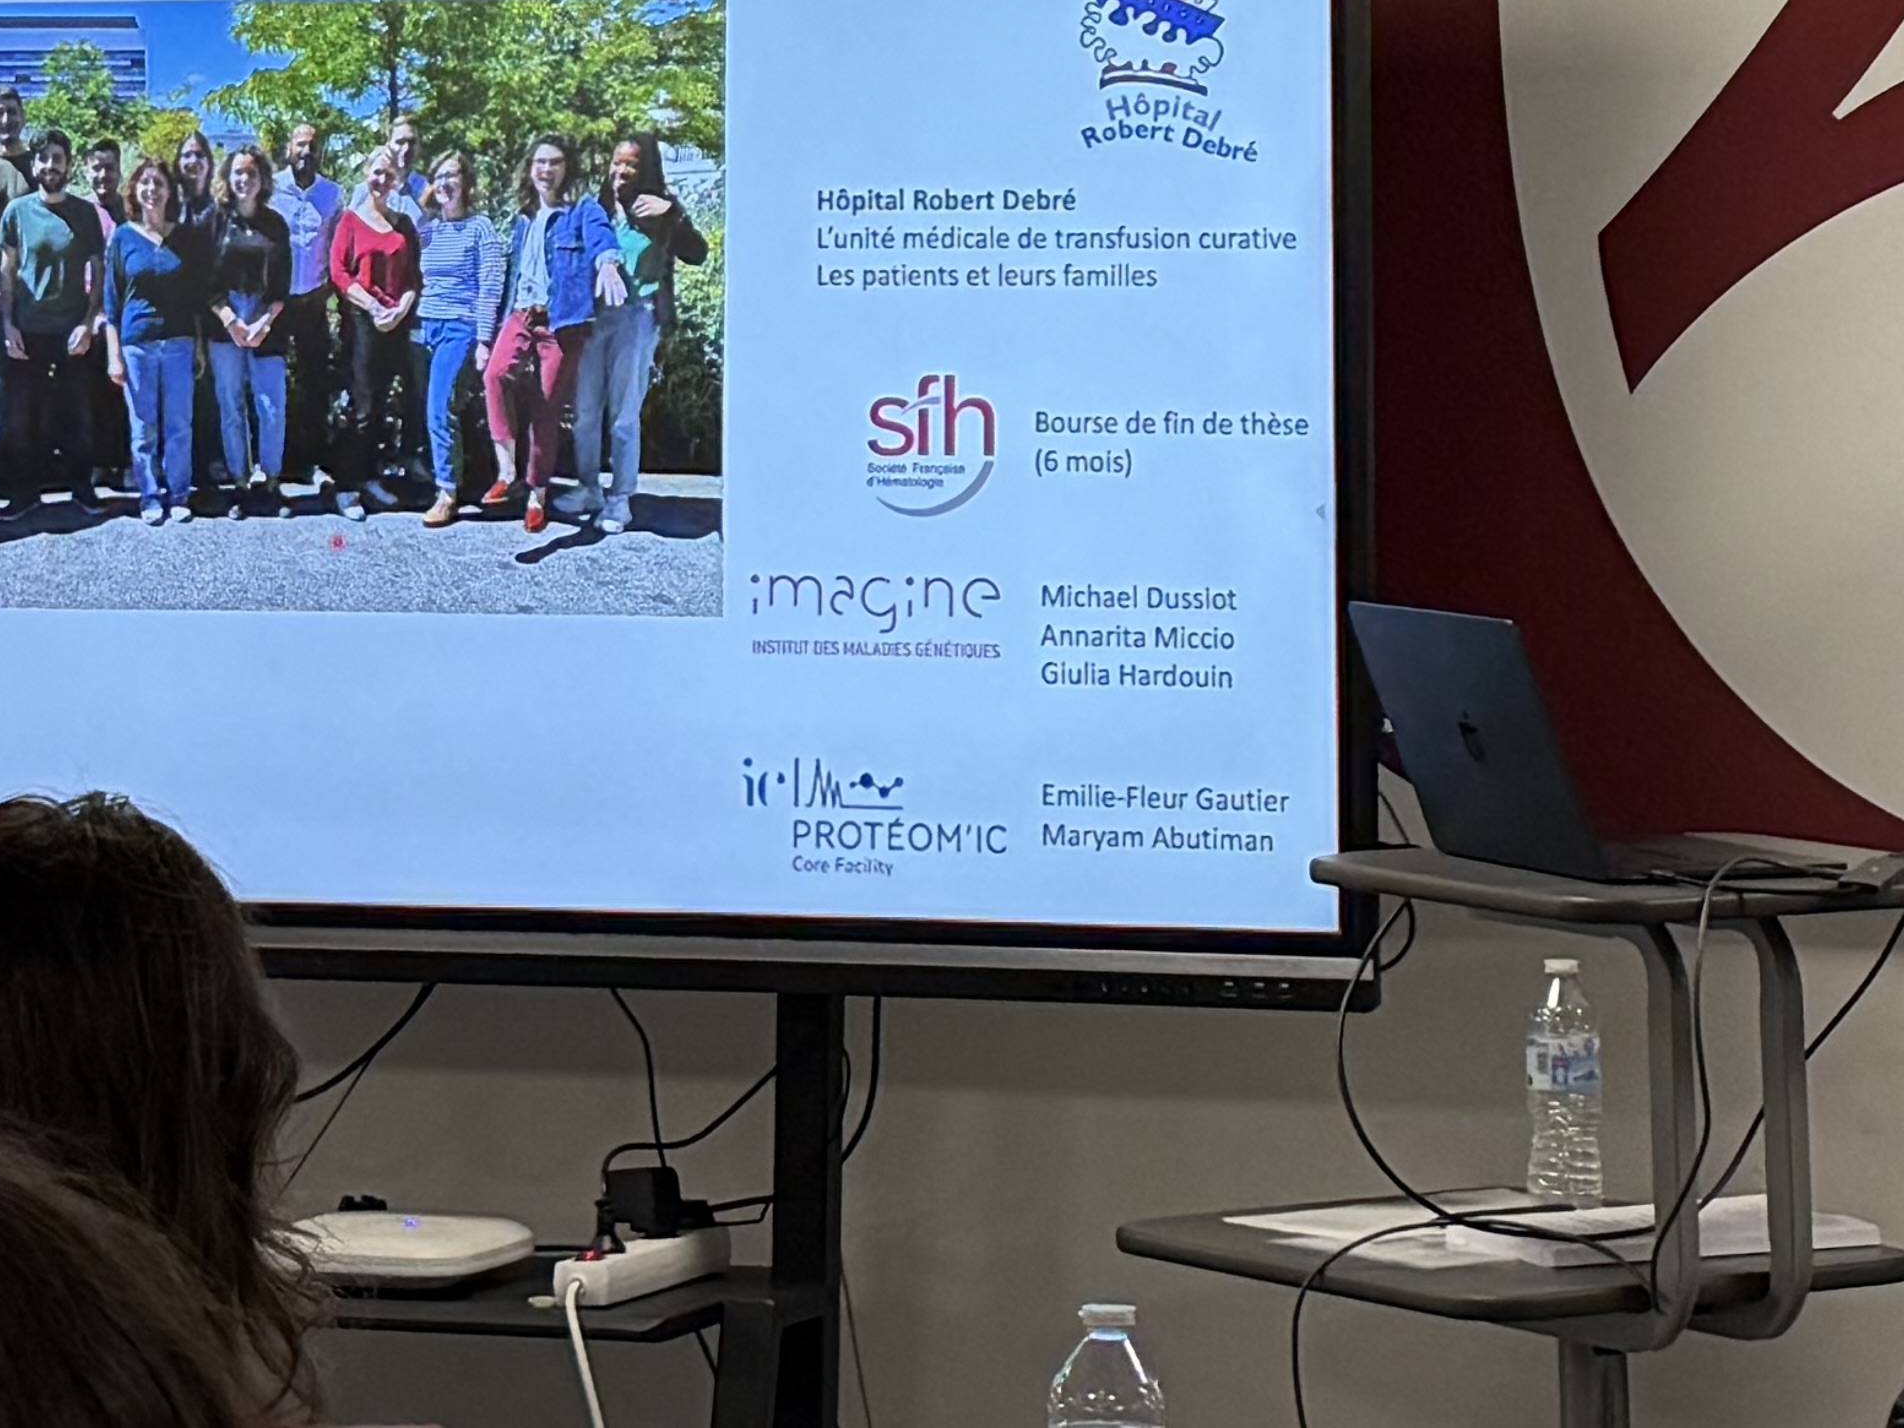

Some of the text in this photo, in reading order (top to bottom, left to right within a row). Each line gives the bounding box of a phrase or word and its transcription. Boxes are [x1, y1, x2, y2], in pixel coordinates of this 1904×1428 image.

[1106, 93, 1222, 131] Hôpital
[1081, 120, 1258, 162] Robert Debré
[817, 187, 1077, 217] Hôpital Robert Debré
[902, 225, 1011, 250] médicale
[1017, 226, 1048, 250] de
[1054, 224, 1191, 250] transfusion
[1198, 226, 1297, 250] curative
[817, 262, 1158, 292] Les patients et leurs familles
[867, 373, 996, 457] sfh
[1035, 409, 1310, 436] Bourse de fin de thèse
[1035, 448, 1132, 479] (6 mois)
[750, 574, 1001, 634] imagine
[1041, 583, 1238, 611] Michael Dussiot
[813, 640, 840, 656] DES
[1040, 623, 1235, 651] Annarita Miccio
[1040, 661, 1233, 689] Giulia Hardouin
[1042, 783, 1290, 813] Emilie-Fleur Gautier
[1042, 823, 1274, 852] Maryam Abutiman
[792, 855, 893, 877] Core Facility
